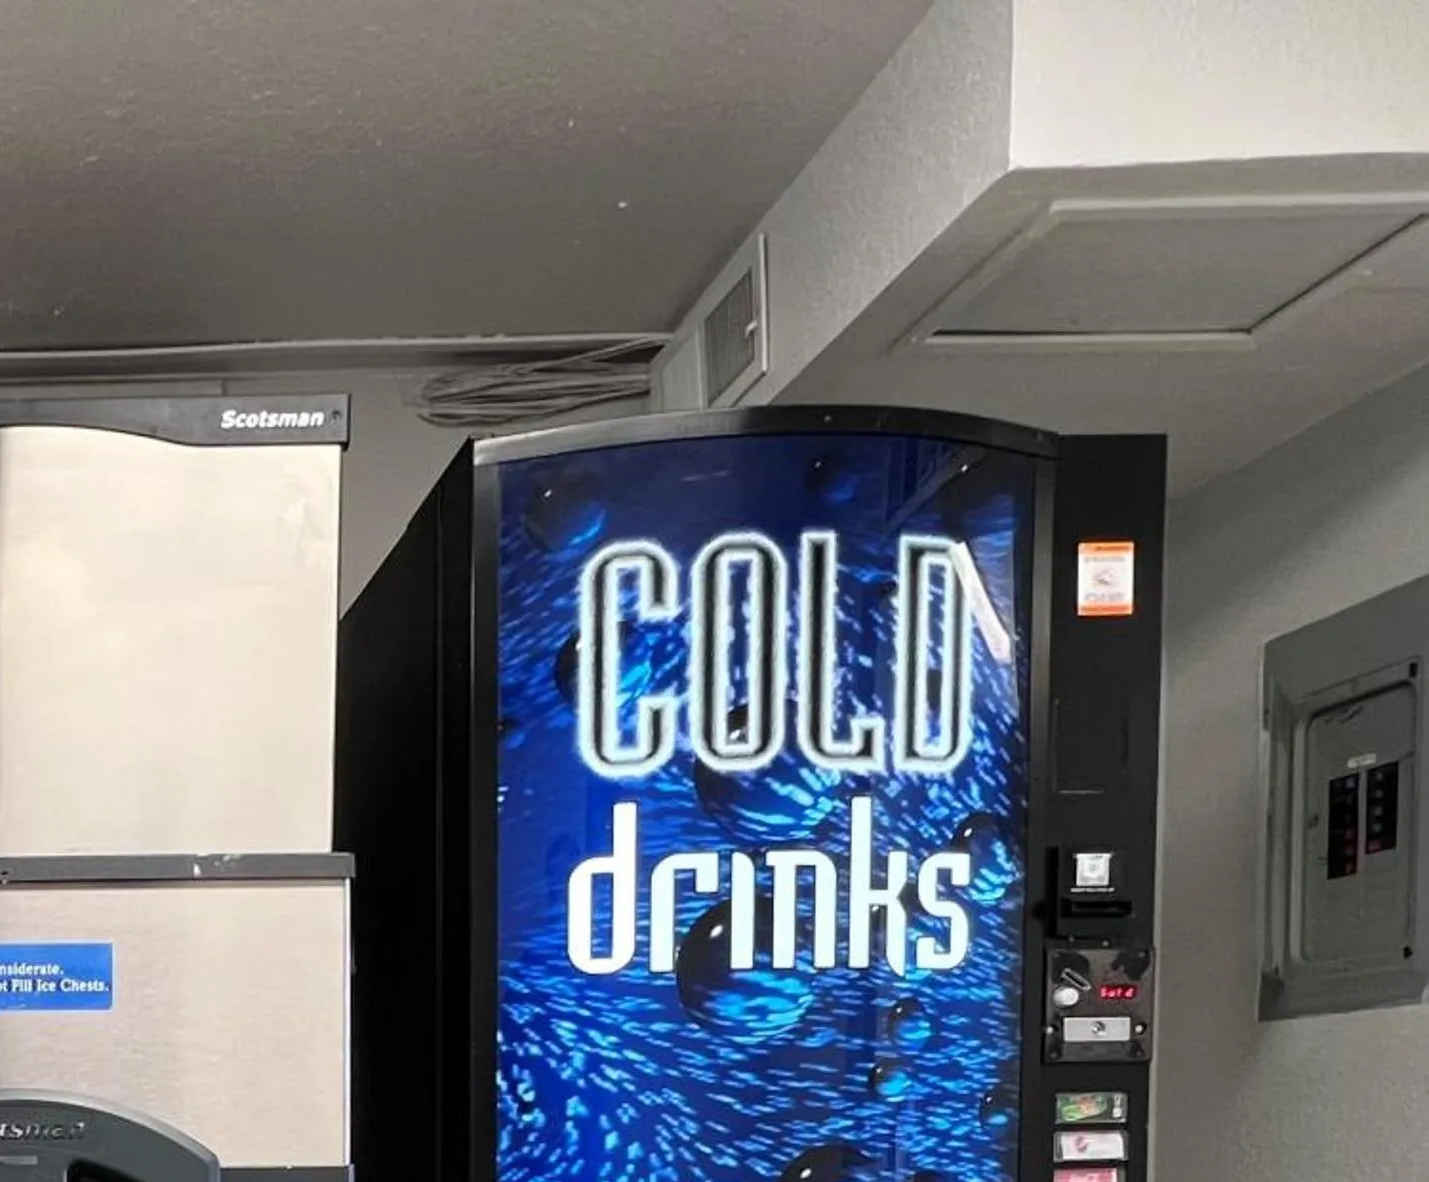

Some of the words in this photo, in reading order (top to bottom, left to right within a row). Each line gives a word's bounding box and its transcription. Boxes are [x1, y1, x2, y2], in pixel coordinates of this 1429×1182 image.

[221, 409, 325, 429] Scotsman
[578, 529, 973, 777] COLD
[567, 796, 971, 976] drinks
[12, 979, 33, 993] Fill
[37, 979, 57, 993] Ice
[60, 978, 110, 993] Chests.
